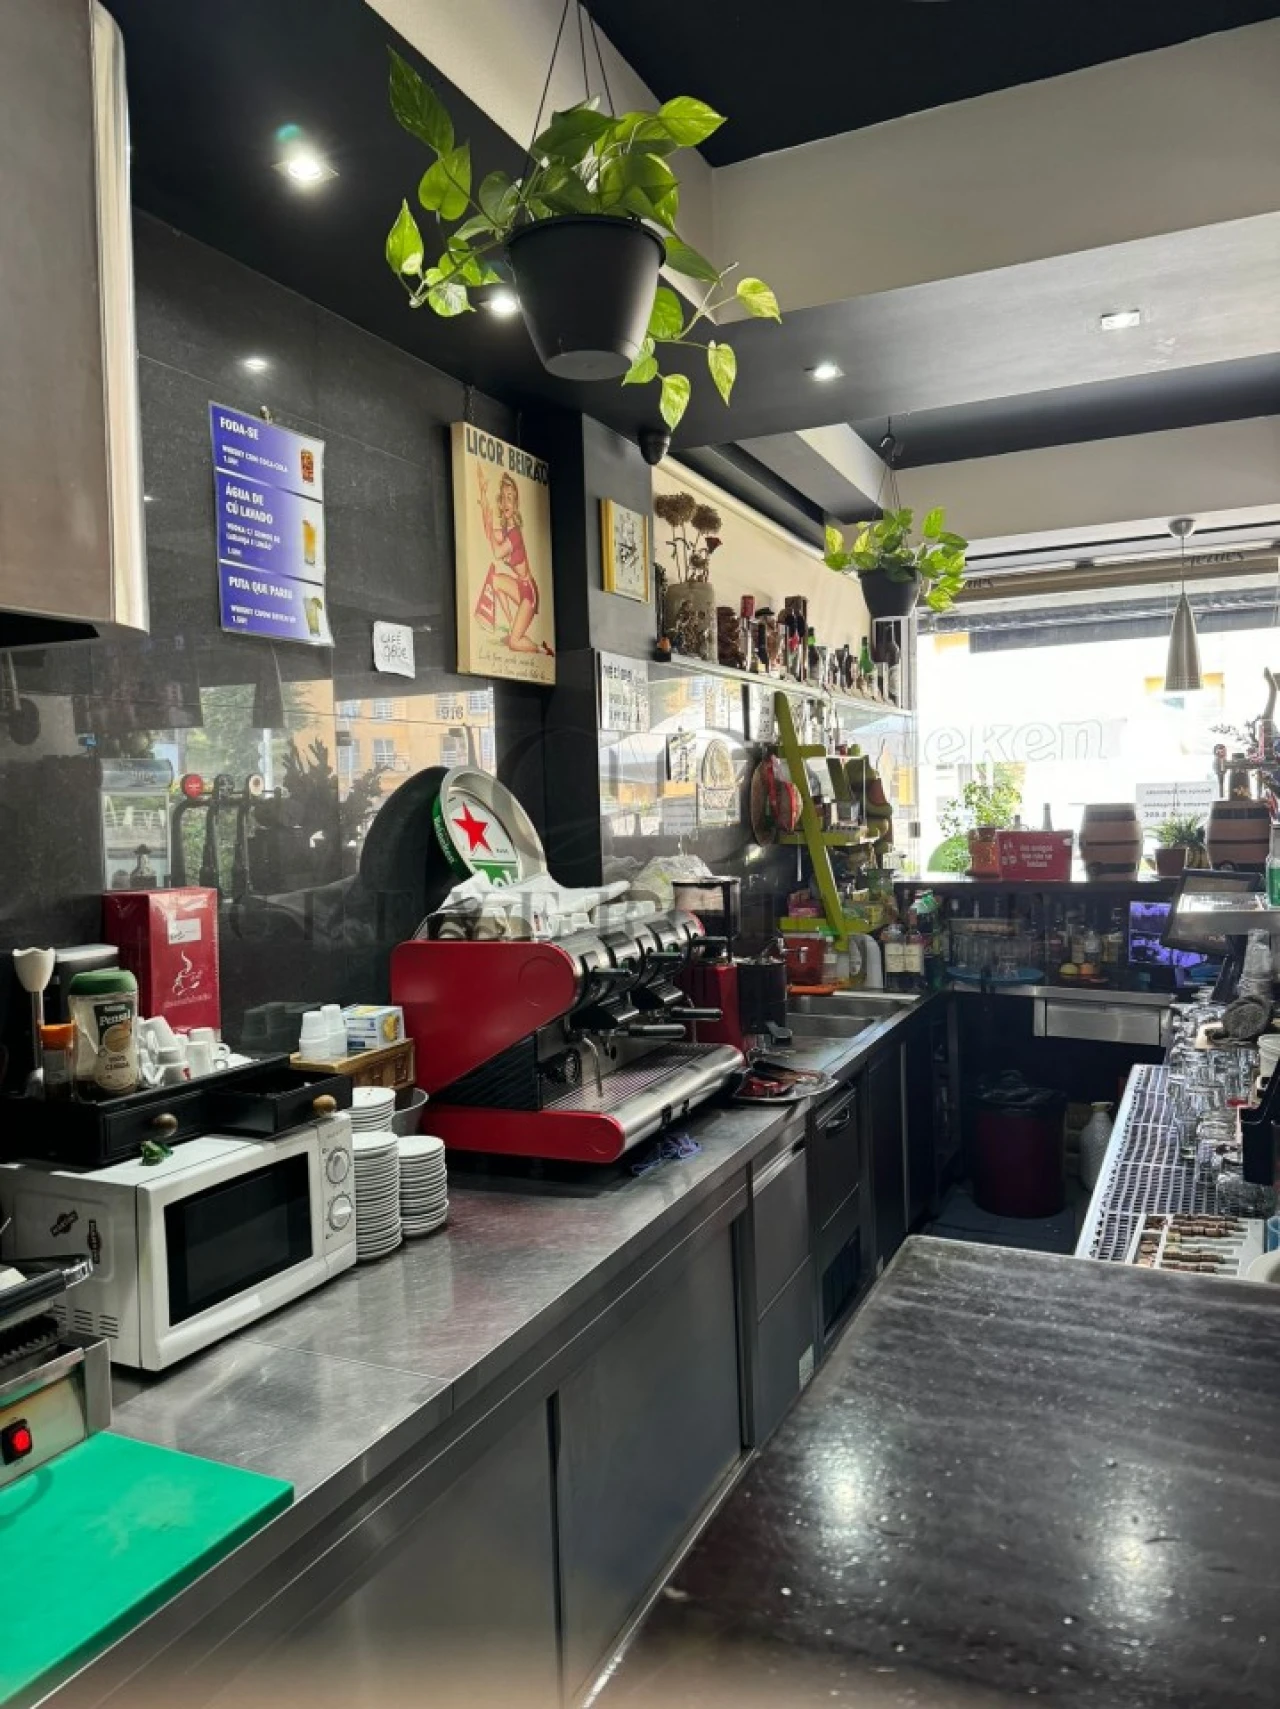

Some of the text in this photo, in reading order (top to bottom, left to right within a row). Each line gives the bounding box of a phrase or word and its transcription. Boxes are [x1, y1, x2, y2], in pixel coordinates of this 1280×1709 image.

[220, 416, 260, 440] FODA-SE
[466, 426, 505, 467] LICOR
[226, 482, 265, 506] ÁGUA DE
[240, 505, 274, 524] LAVADO
[229, 576, 250, 591] PUTA
[251, 581, 268, 595] QUE
